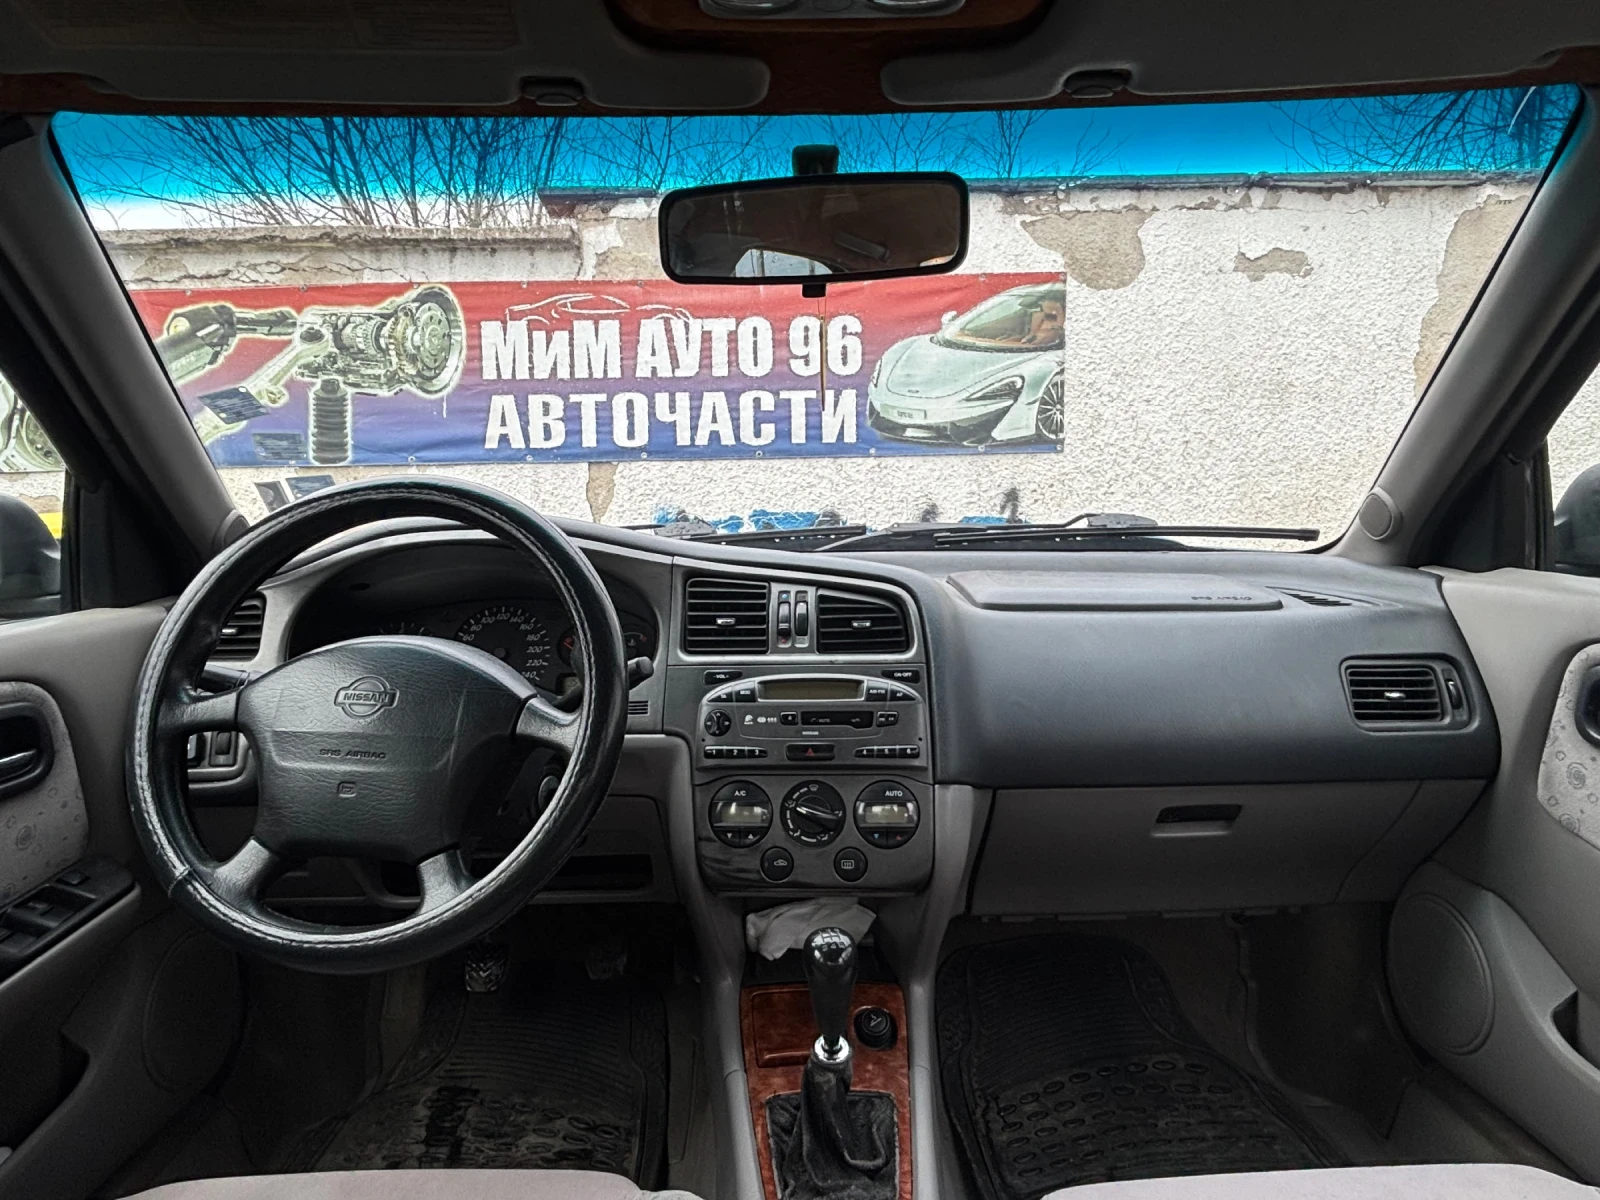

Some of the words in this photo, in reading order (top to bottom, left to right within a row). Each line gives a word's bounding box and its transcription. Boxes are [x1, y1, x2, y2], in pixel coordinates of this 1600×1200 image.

[480, 319, 622, 380] МиМ
[635, 316, 773, 379] АУТО
[788, 315, 863, 377] 96
[484, 389, 858, 450] АВТОЧАСТИ
[480, 616, 496, 624] 100
[496, 612, 510, 620] 120
[526, 659, 543, 667] 220
[343, 692, 389, 703] NISSAN
[319, 748, 342, 757] SRS
[345, 750, 387, 759] AIRBAG
